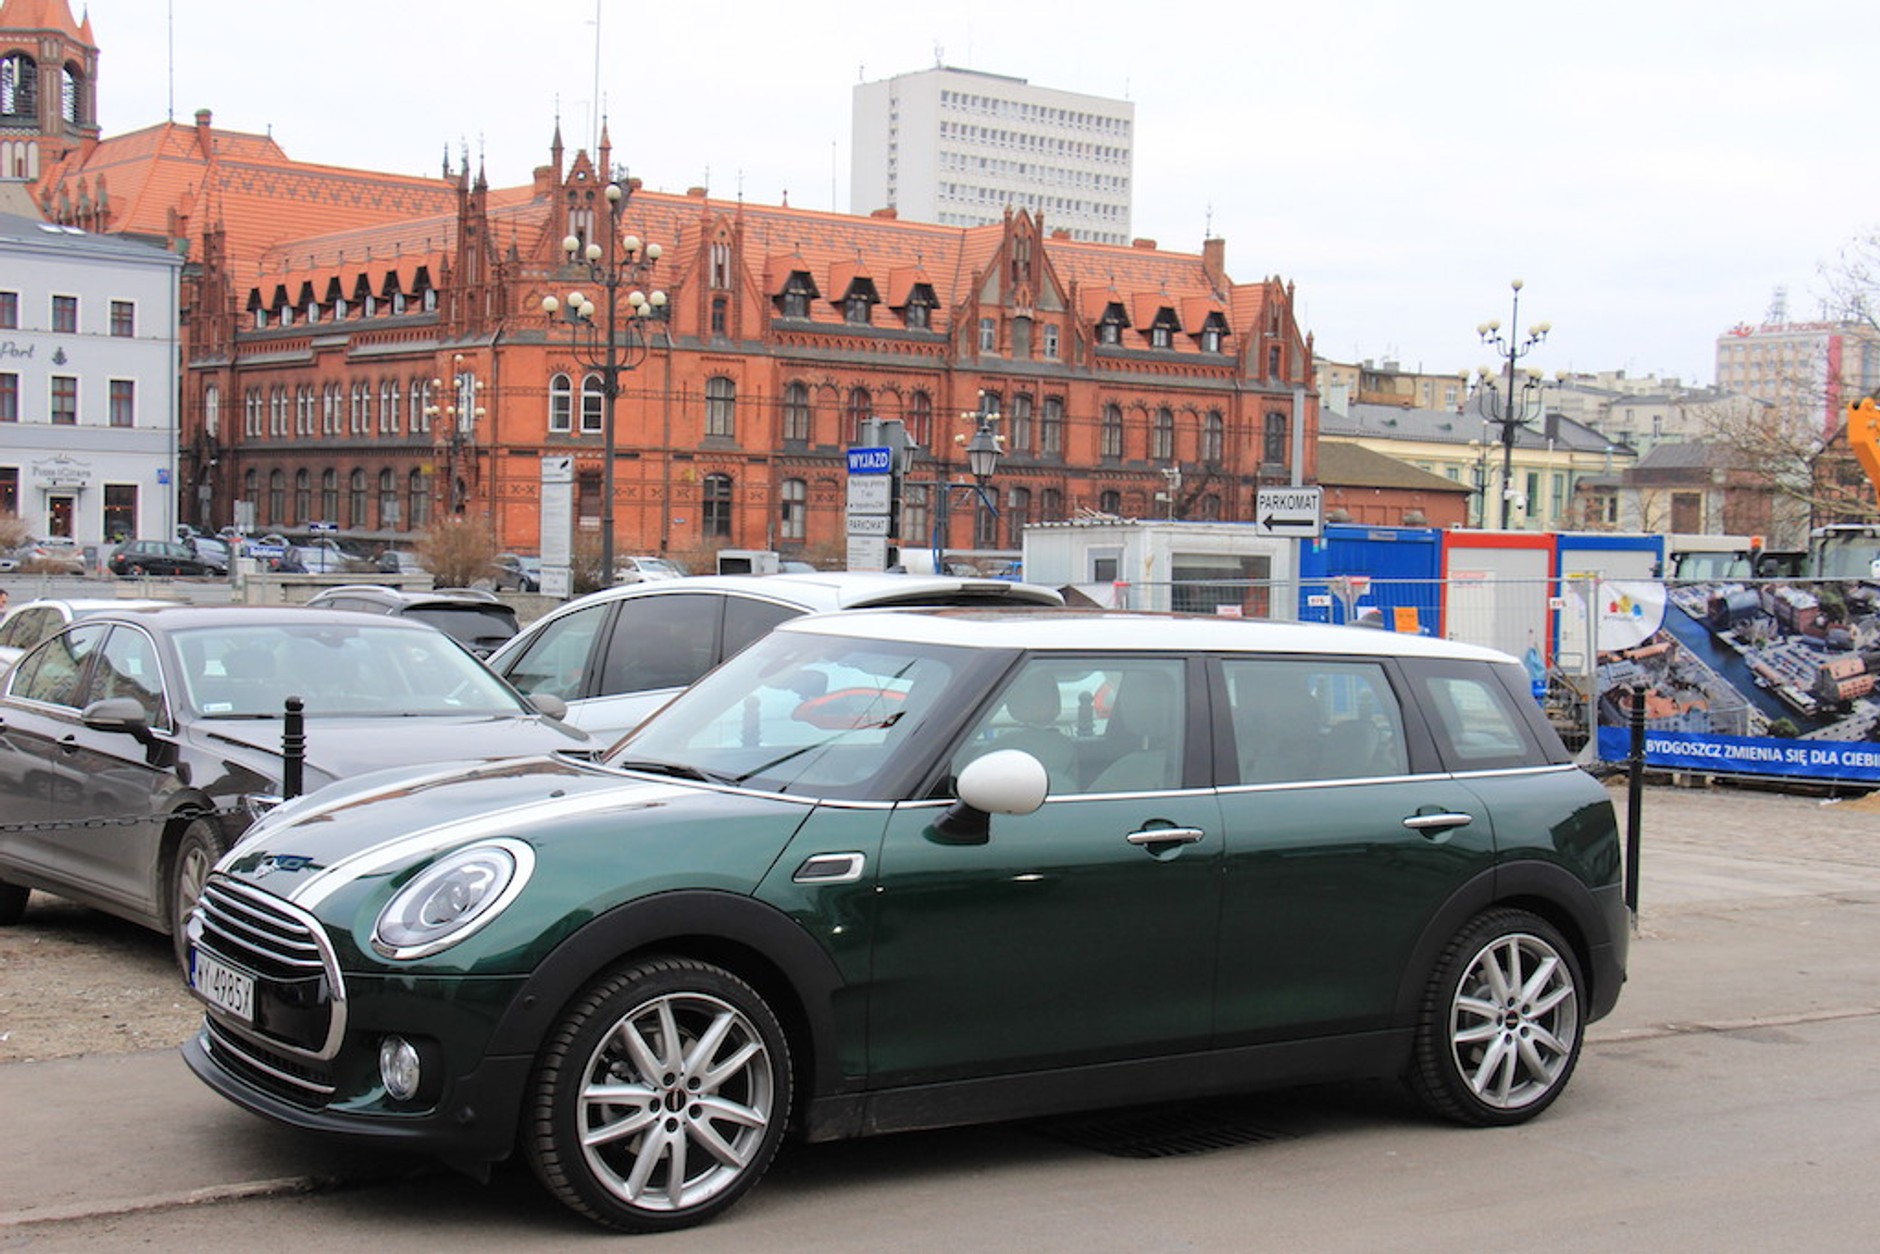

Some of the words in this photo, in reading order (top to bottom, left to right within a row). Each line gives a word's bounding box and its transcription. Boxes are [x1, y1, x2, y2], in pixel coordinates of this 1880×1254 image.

[849, 453, 888, 469] WYJAZD
[1259, 495, 1318, 510] PARKOMAT
[849, 520, 885, 530] PARKOMAT
[1646, 738, 1721, 758] BYDGOSZCZ
[1724, 744, 1783, 762] ZMIENIA
[1786, 748, 1808, 766] SIĘ
[1810, 750, 1838, 765] DLA
[1841, 752, 1880, 768] CIEBI
